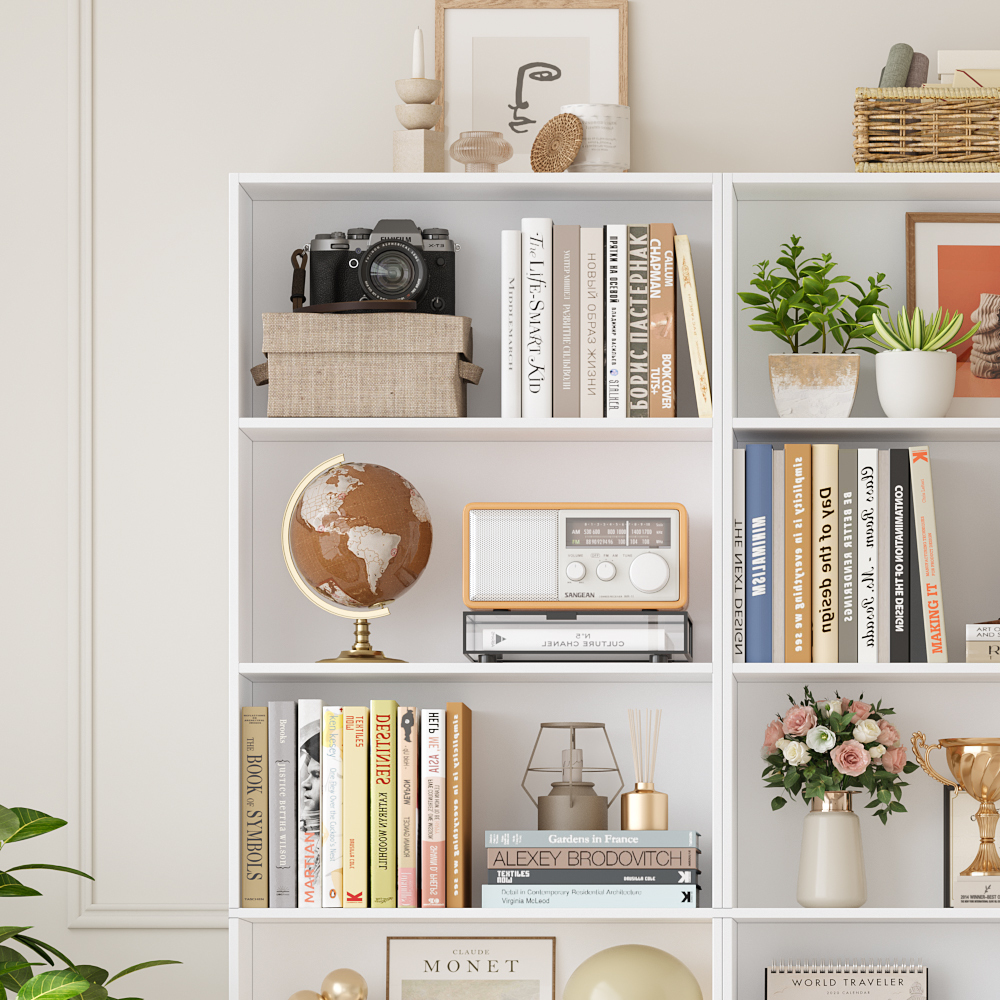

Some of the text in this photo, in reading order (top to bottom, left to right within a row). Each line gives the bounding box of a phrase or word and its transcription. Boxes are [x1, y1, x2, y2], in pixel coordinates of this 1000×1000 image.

[530, 232, 544, 258] The
[650, 239, 661, 298] CHAPMAN
[665, 251, 673, 286] CALLUM
[609, 236, 619, 303] ПРЯТКИ НА ОСЕВОЙ
[587, 253, 597, 396] НОВЫЙ ОБРАЗ ЖИЗНИ
[630, 233, 648, 410] БОРИС ПАСТЕРНАК
[651, 368, 660, 394] TUTS+
[662, 354, 671, 408] BOOK COVER
[926, 583, 943, 654] MAKING IT
[327, 715, 338, 758] ken kesey
[247, 755, 262, 794] BOOK
[247, 798, 254, 807] OF
[329, 768, 337, 861] One Flew Over the Cuckoo's Nest
[247, 810, 263, 880] SYMBOLS
[493, 851, 562, 866] ALEXEY
[568, 851, 682, 866] BRODOVITCH
[549, 835, 639, 844] Gardens in France
[304, 832, 314, 903] MARTIAN
[424, 959, 519, 973] MONET
